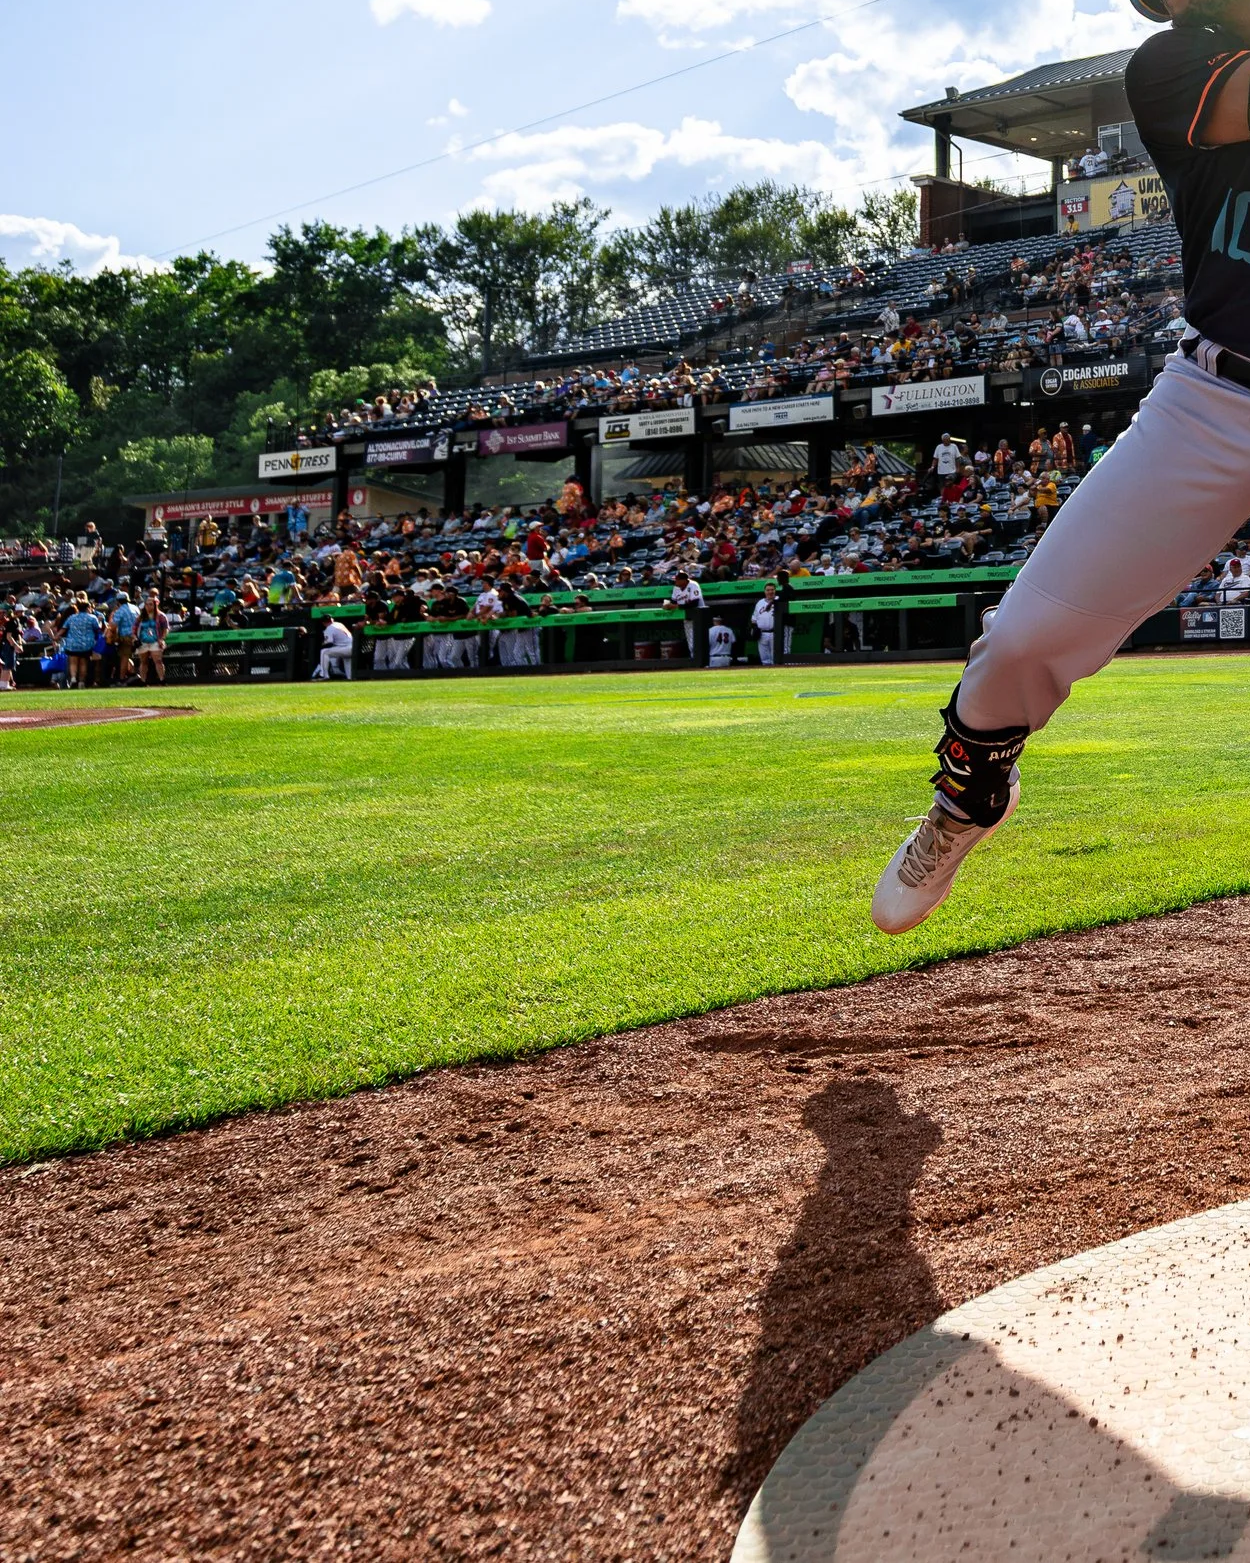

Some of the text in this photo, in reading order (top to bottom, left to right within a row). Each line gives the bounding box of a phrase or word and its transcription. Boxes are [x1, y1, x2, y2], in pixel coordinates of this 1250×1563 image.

[1066, 202, 1083, 214] 315
[1063, 363, 1129, 381] EDGAR SNYDER
[1073, 376, 1120, 391] & ASSOCIATES
[900, 383, 977, 402] FULLINGTON
[517, 432, 542, 444] SUMMIT
[542, 430, 560, 441] BANK
[224, 499, 244, 509] STYLE
